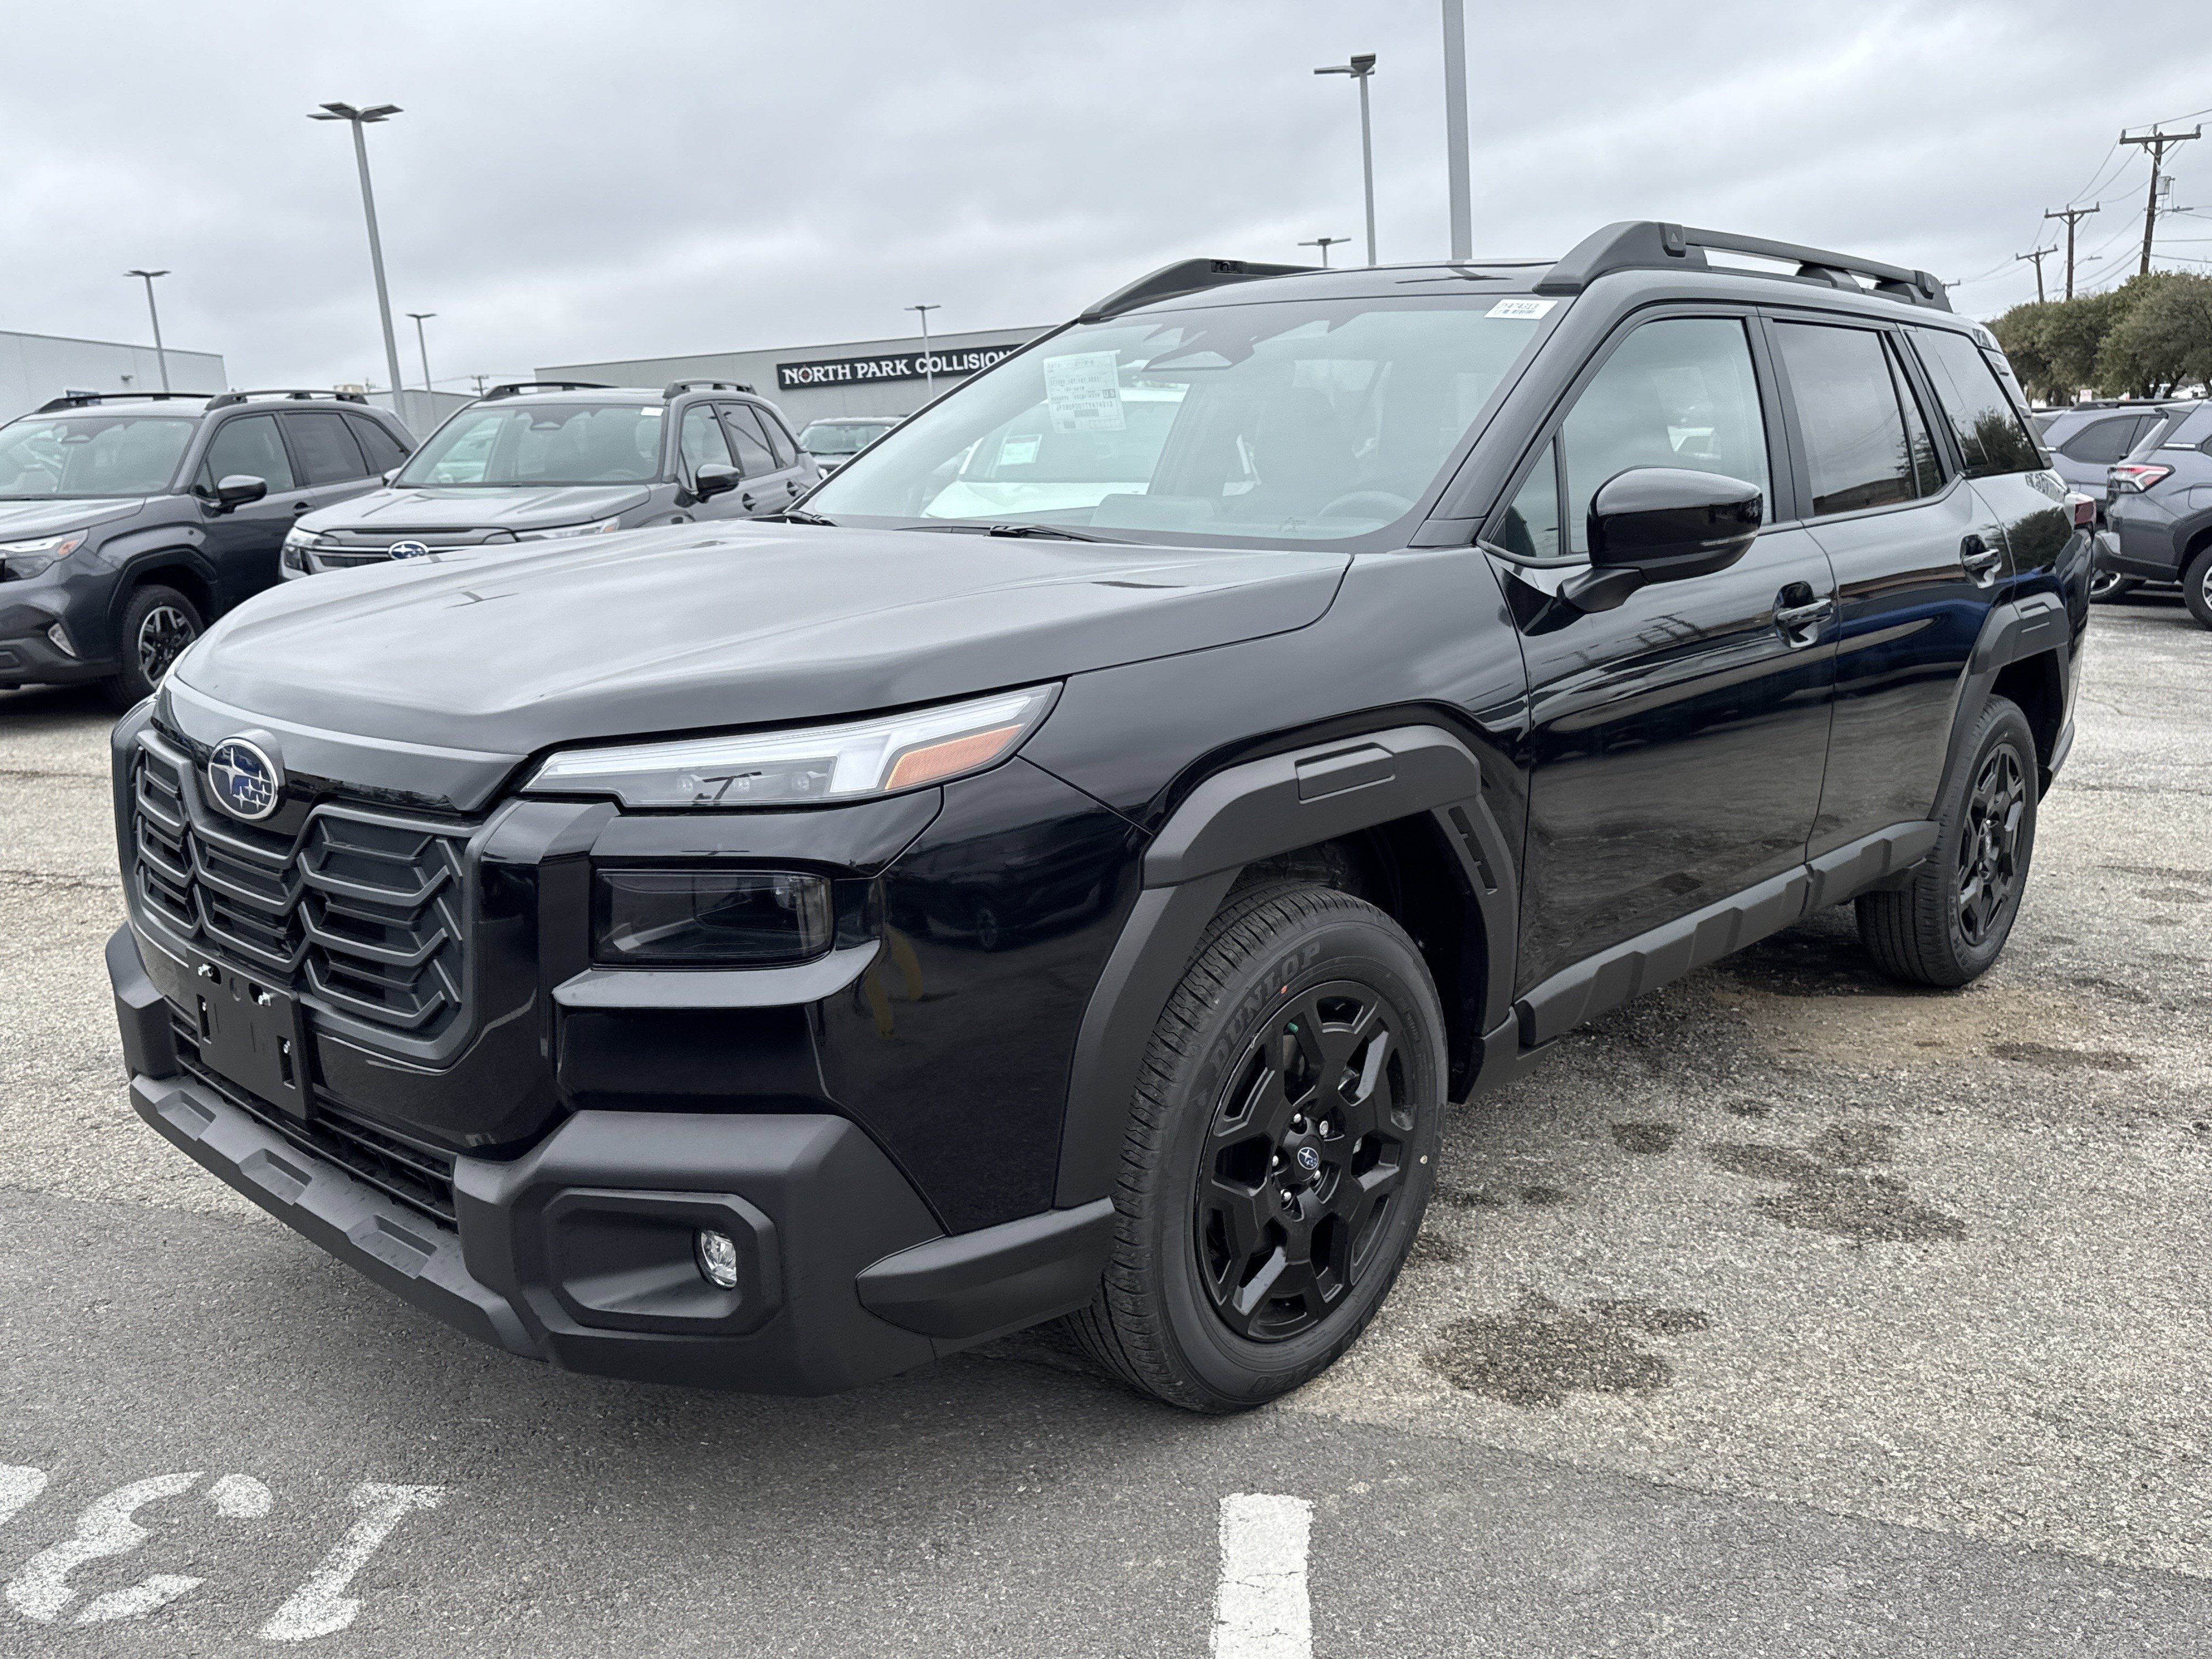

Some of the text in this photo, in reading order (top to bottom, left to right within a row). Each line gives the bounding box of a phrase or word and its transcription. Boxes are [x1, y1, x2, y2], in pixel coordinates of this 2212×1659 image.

[782, 364, 852, 385] NORTH
[854, 359, 912, 379] PARK
[1210, 940, 1321, 1078] DUNLOP
